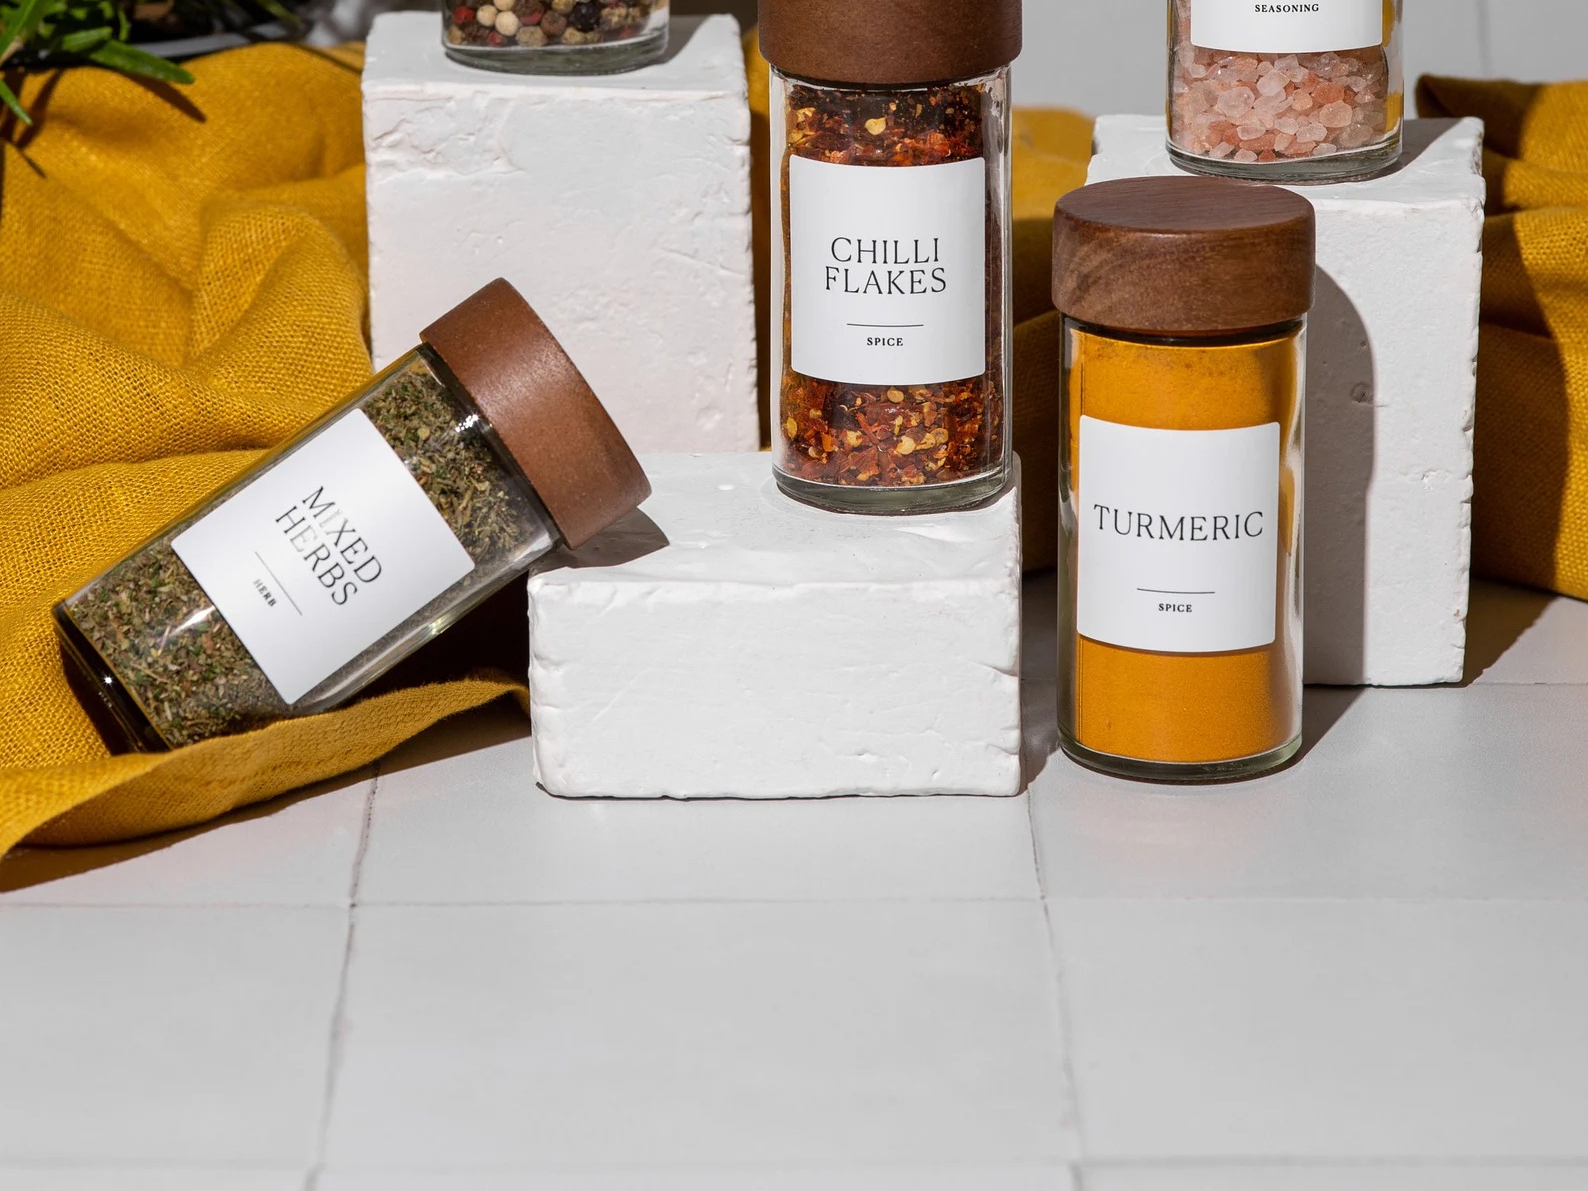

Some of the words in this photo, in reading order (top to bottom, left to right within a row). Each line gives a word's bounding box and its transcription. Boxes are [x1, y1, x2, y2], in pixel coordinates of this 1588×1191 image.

[1253, 3, 1321, 14] SEASONING
[830, 236, 941, 265] CHILLI
[824, 266, 948, 295] FLAKES
[866, 336, 905, 348] SPICE
[302, 485, 382, 585] MIXED
[1093, 503, 1265, 542] TURMERIC
[275, 505, 358, 606] HERBS
[252, 578, 277, 608] HERB
[1157, 602, 1194, 614] SPICE
